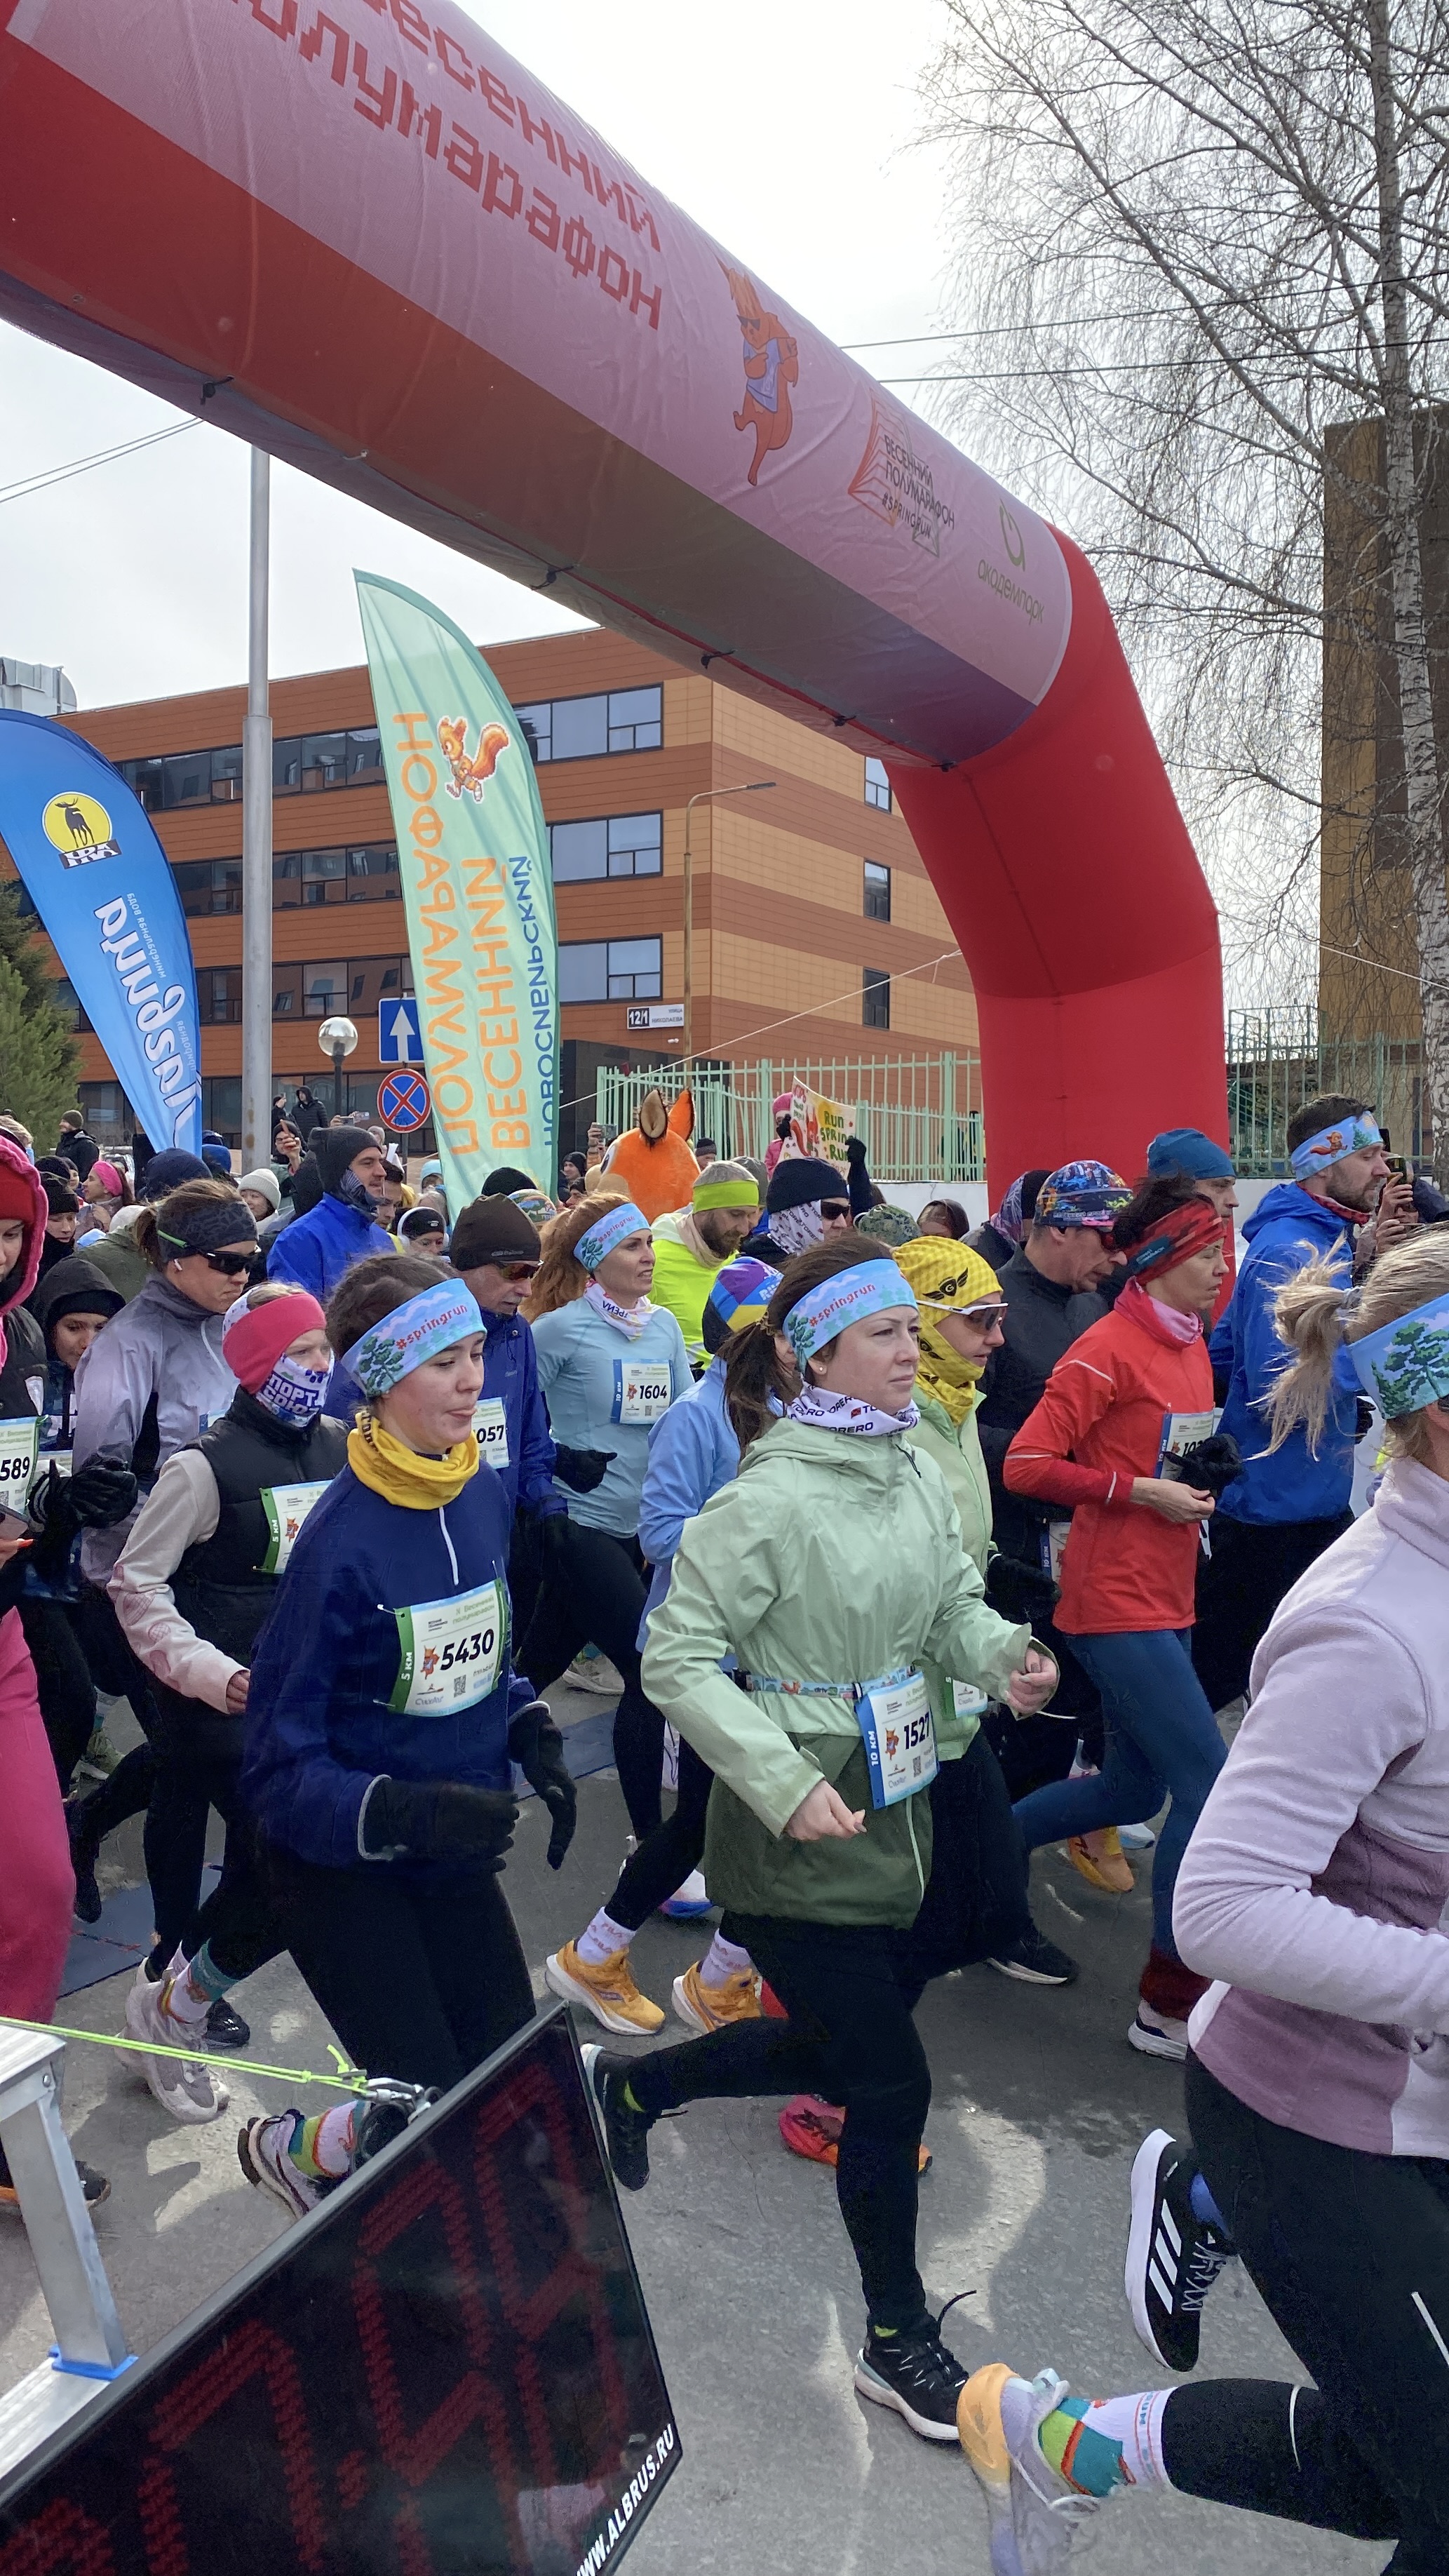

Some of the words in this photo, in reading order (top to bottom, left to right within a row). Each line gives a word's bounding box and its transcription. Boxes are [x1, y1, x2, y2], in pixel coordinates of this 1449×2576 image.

[361, 0, 661, 252] есенний
[231, 0, 661, 330] олумарафон
[884, 434, 934, 490] ВЕСЕННИЙ
[882, 492, 931, 539] #SPRINGRUN
[886, 459, 955, 530] ПОЛУМАРАФОН
[977, 558, 1044, 625] академпарк
[629, 1009, 649, 1025] 12/1
[395, 1304, 468, 1350] #springrun
[809, 1283, 877, 1327] #springrun
[267, 1374, 317, 1407] ПОРТ
[640, 1385, 668, 1400] 1604
[474, 1424, 504, 1444] 057
[440, 1628, 494, 1670] 5430
[903, 1712, 929, 1750] 1527
[577, 2423, 674, 2576] WW.ALBRUS.RU
